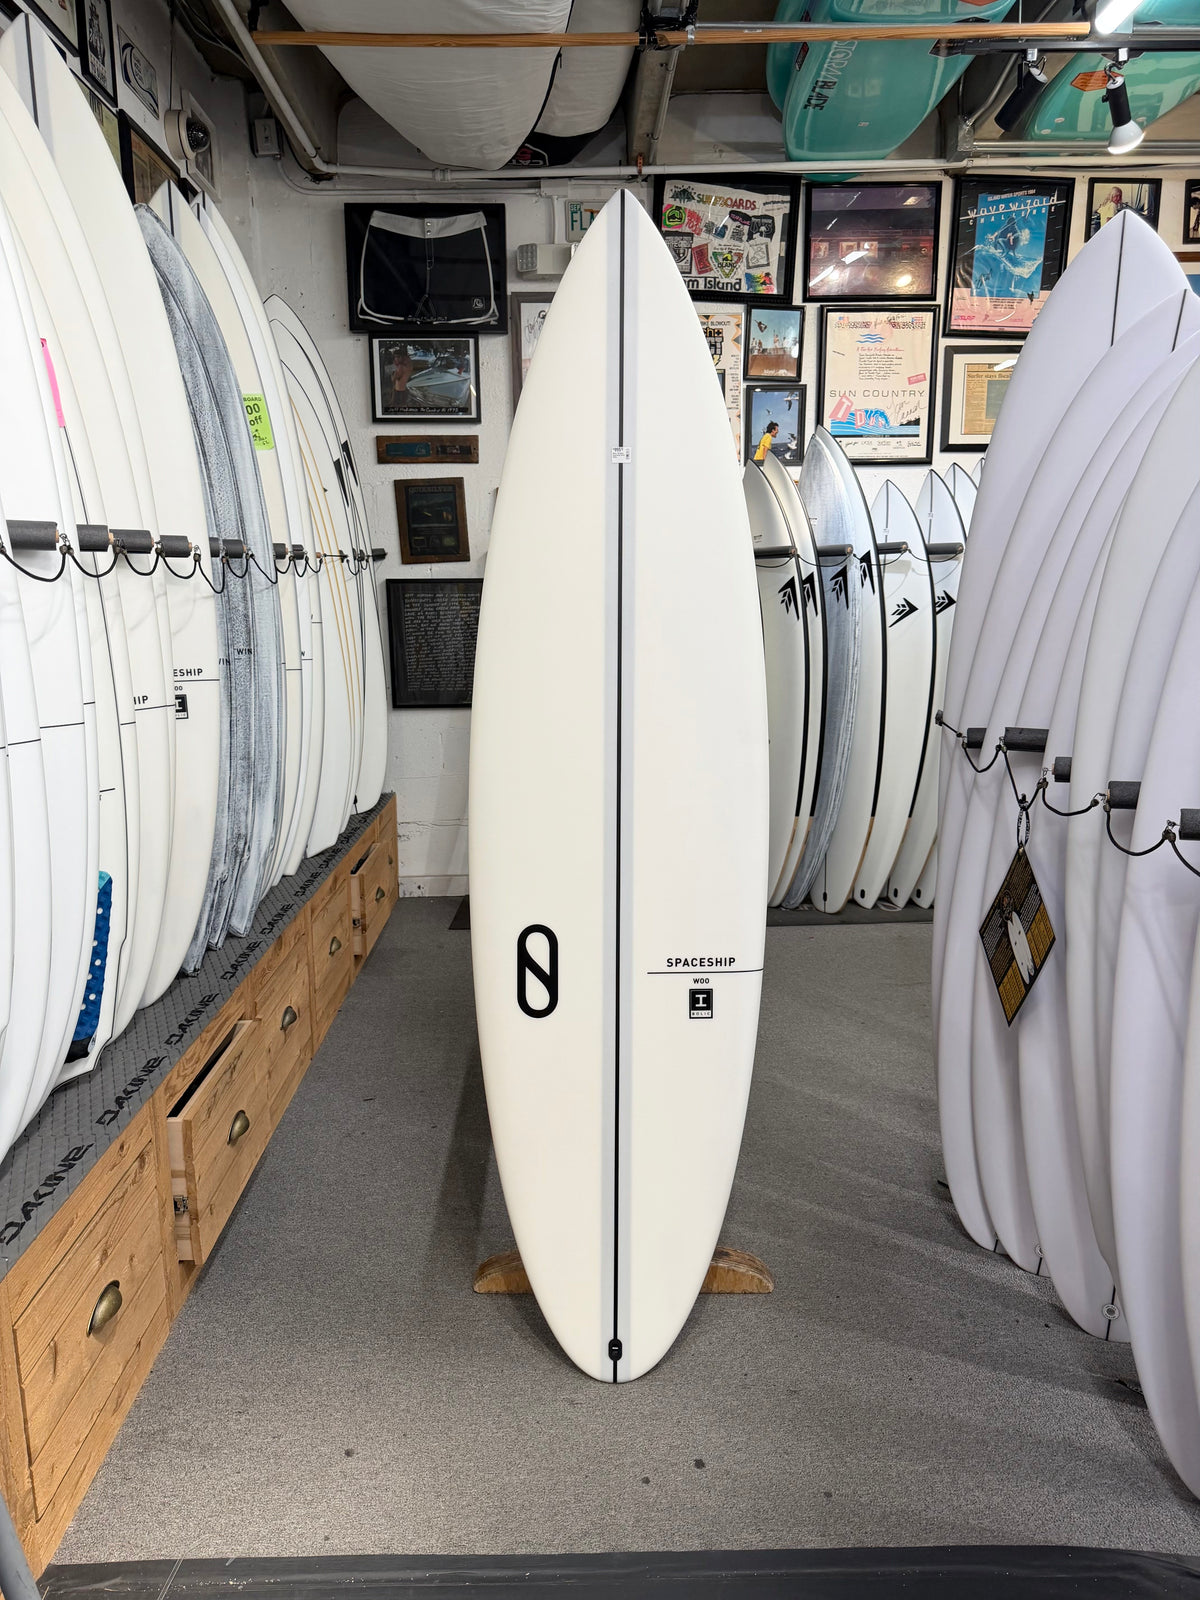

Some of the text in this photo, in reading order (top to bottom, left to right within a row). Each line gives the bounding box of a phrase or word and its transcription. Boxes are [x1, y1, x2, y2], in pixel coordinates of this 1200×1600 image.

[704, 277, 742, 292] Island
[829, 389, 925, 398] SUN COUNTRY
[249, 415, 263, 426] off
[259, 903, 295, 936] DAKINE
[219, 940, 264, 981] DAKINE
[666, 957, 736, 967] SPACESHIP
[164, 993, 219, 1046] DAKINE
[95, 1055, 167, 1126] DAKINE
[0, 1143, 94, 1246] DAKINE
